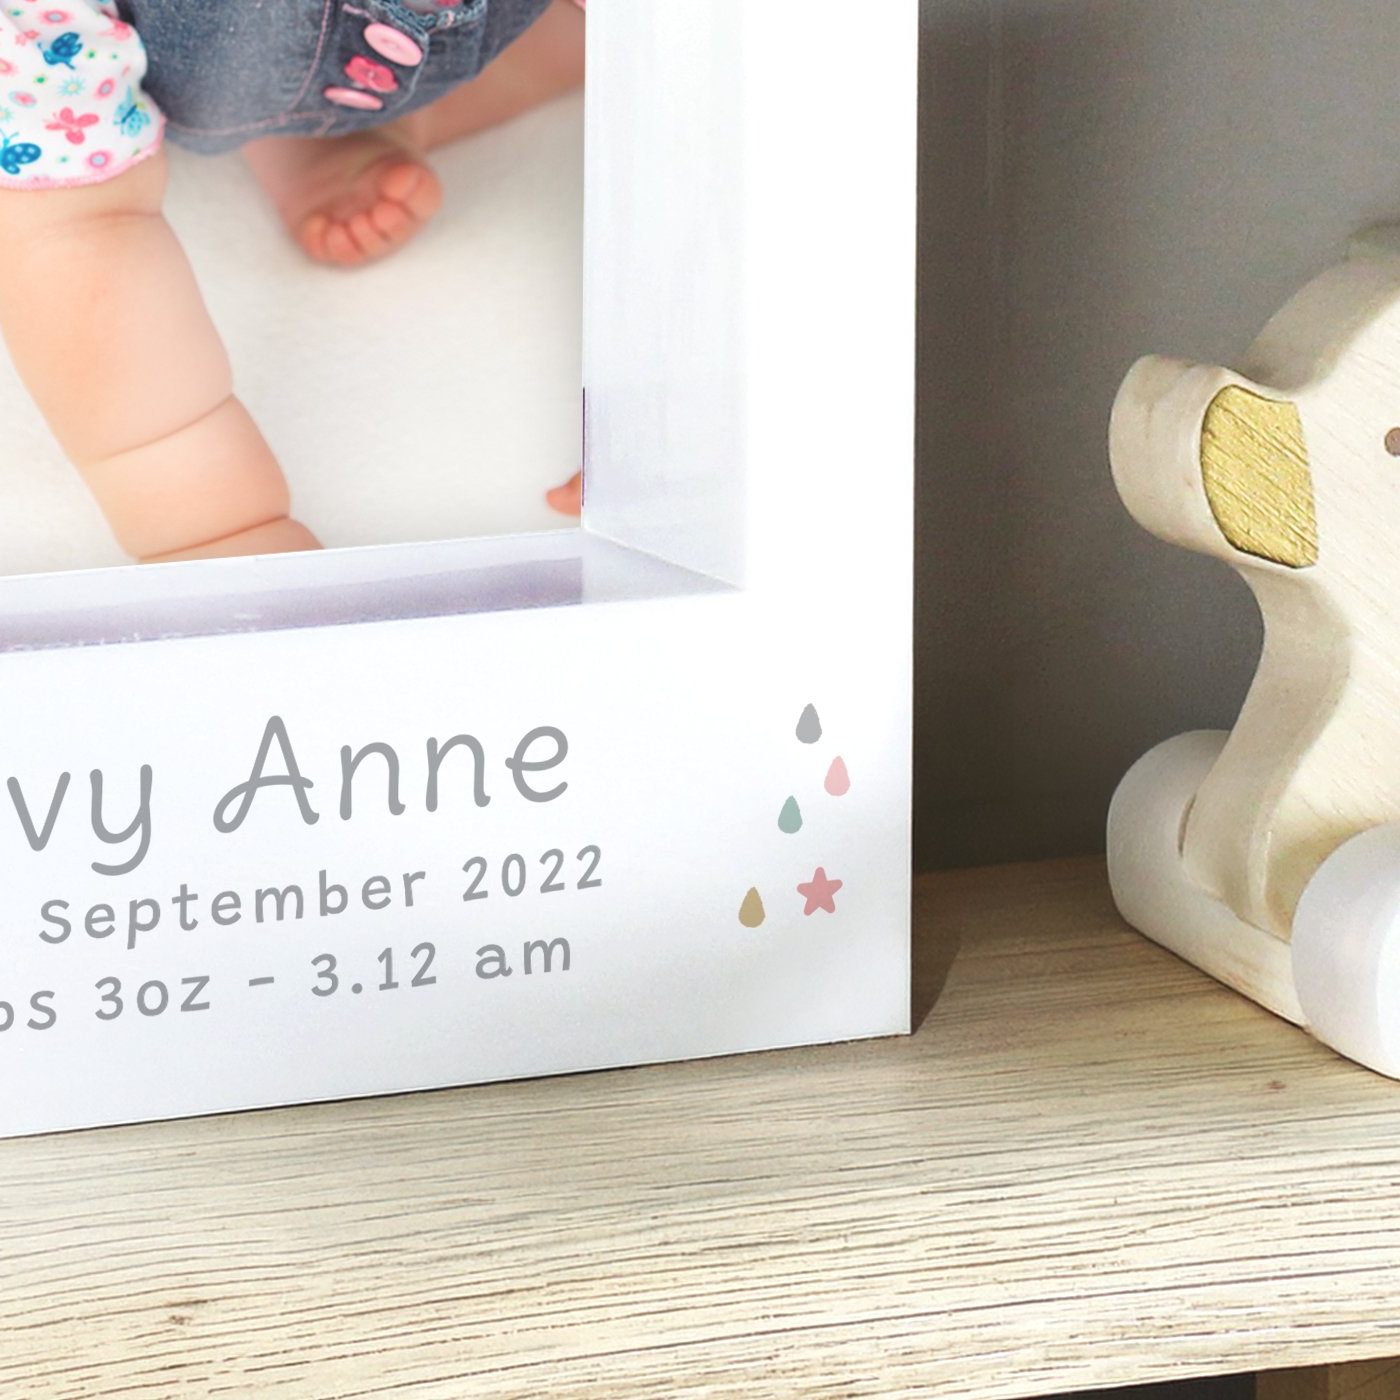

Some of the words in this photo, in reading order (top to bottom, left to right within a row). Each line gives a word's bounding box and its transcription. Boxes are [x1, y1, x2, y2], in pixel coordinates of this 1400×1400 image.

[212, 715, 569, 834] Anne
[38, 869, 426, 950] September
[462, 844, 602, 902] 2022
[94, 975, 211, 1021] 3oz
[248, 976, 275, 987] -
[310, 941, 437, 998] 3.12
[475, 937, 571, 980] am
